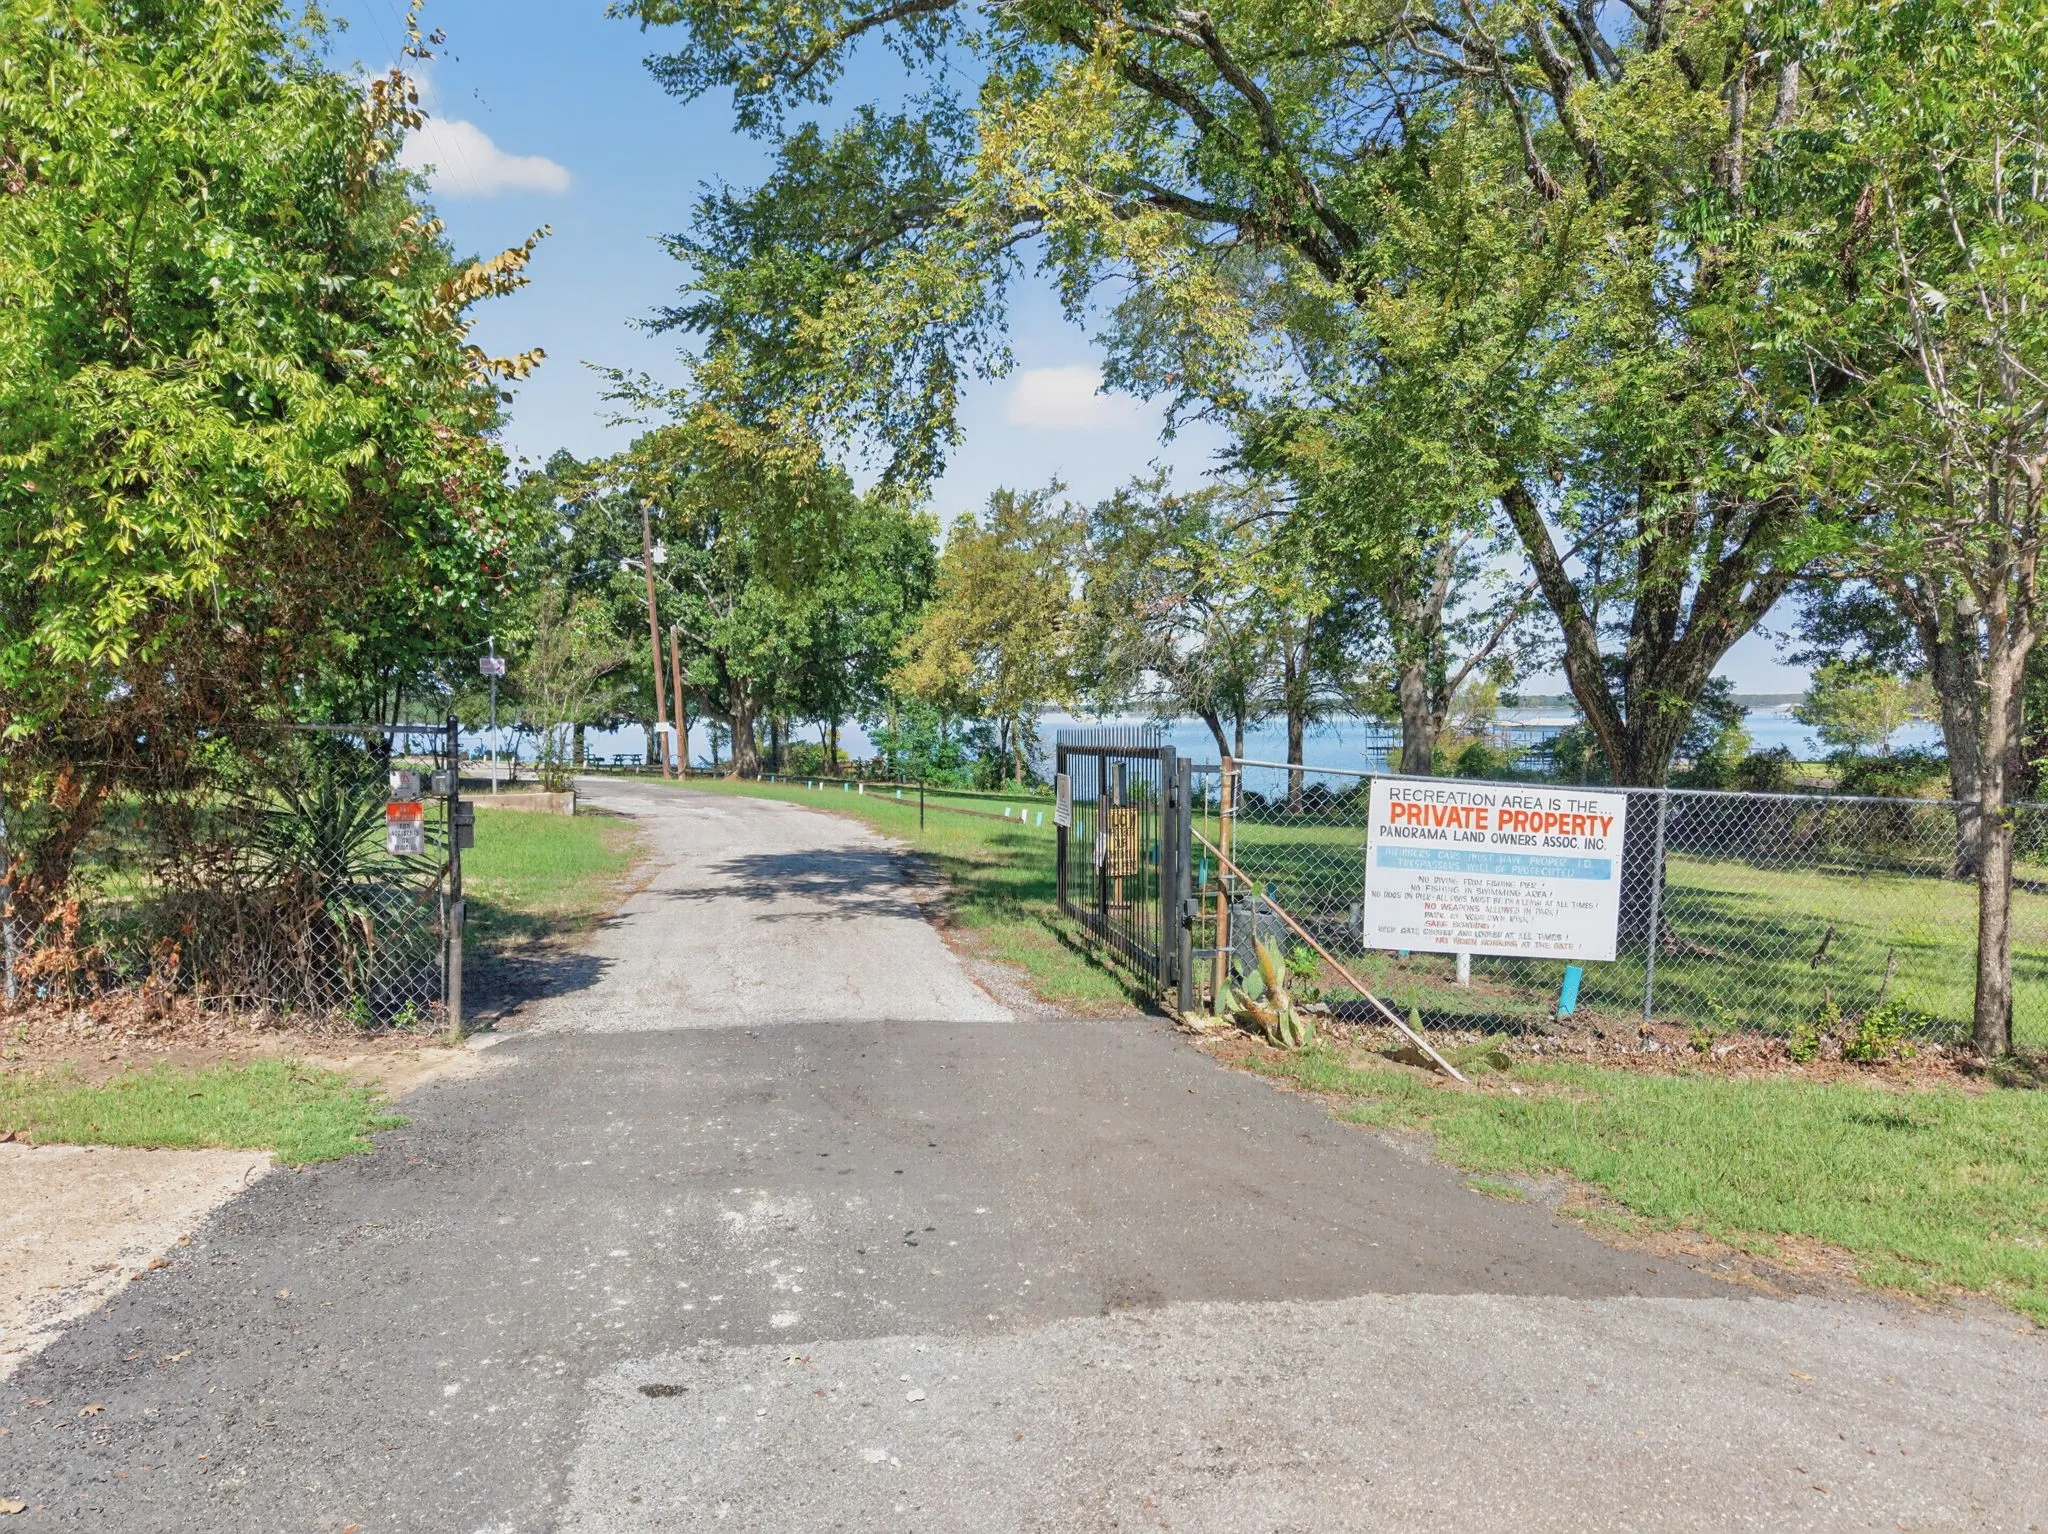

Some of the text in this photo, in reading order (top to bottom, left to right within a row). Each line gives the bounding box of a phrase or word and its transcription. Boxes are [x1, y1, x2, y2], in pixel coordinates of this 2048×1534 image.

[1389, 787, 1496, 807] RECREATION
[1502, 795, 1543, 809] AREA
[1548, 798, 1561, 810] IS
[1390, 802, 1614, 837] PRIVATE PROPERTY
[1380, 825, 1607, 851] PANORAMA LAND OWNERS ASSOC. INC.
[1499, 855, 1522, 864] HAVE
[1495, 864, 1507, 873] BE
[1426, 885, 1459, 893] FISHING
[1476, 888, 1521, 896] SWIMMING
[1441, 903, 1480, 912] WEAPONS
